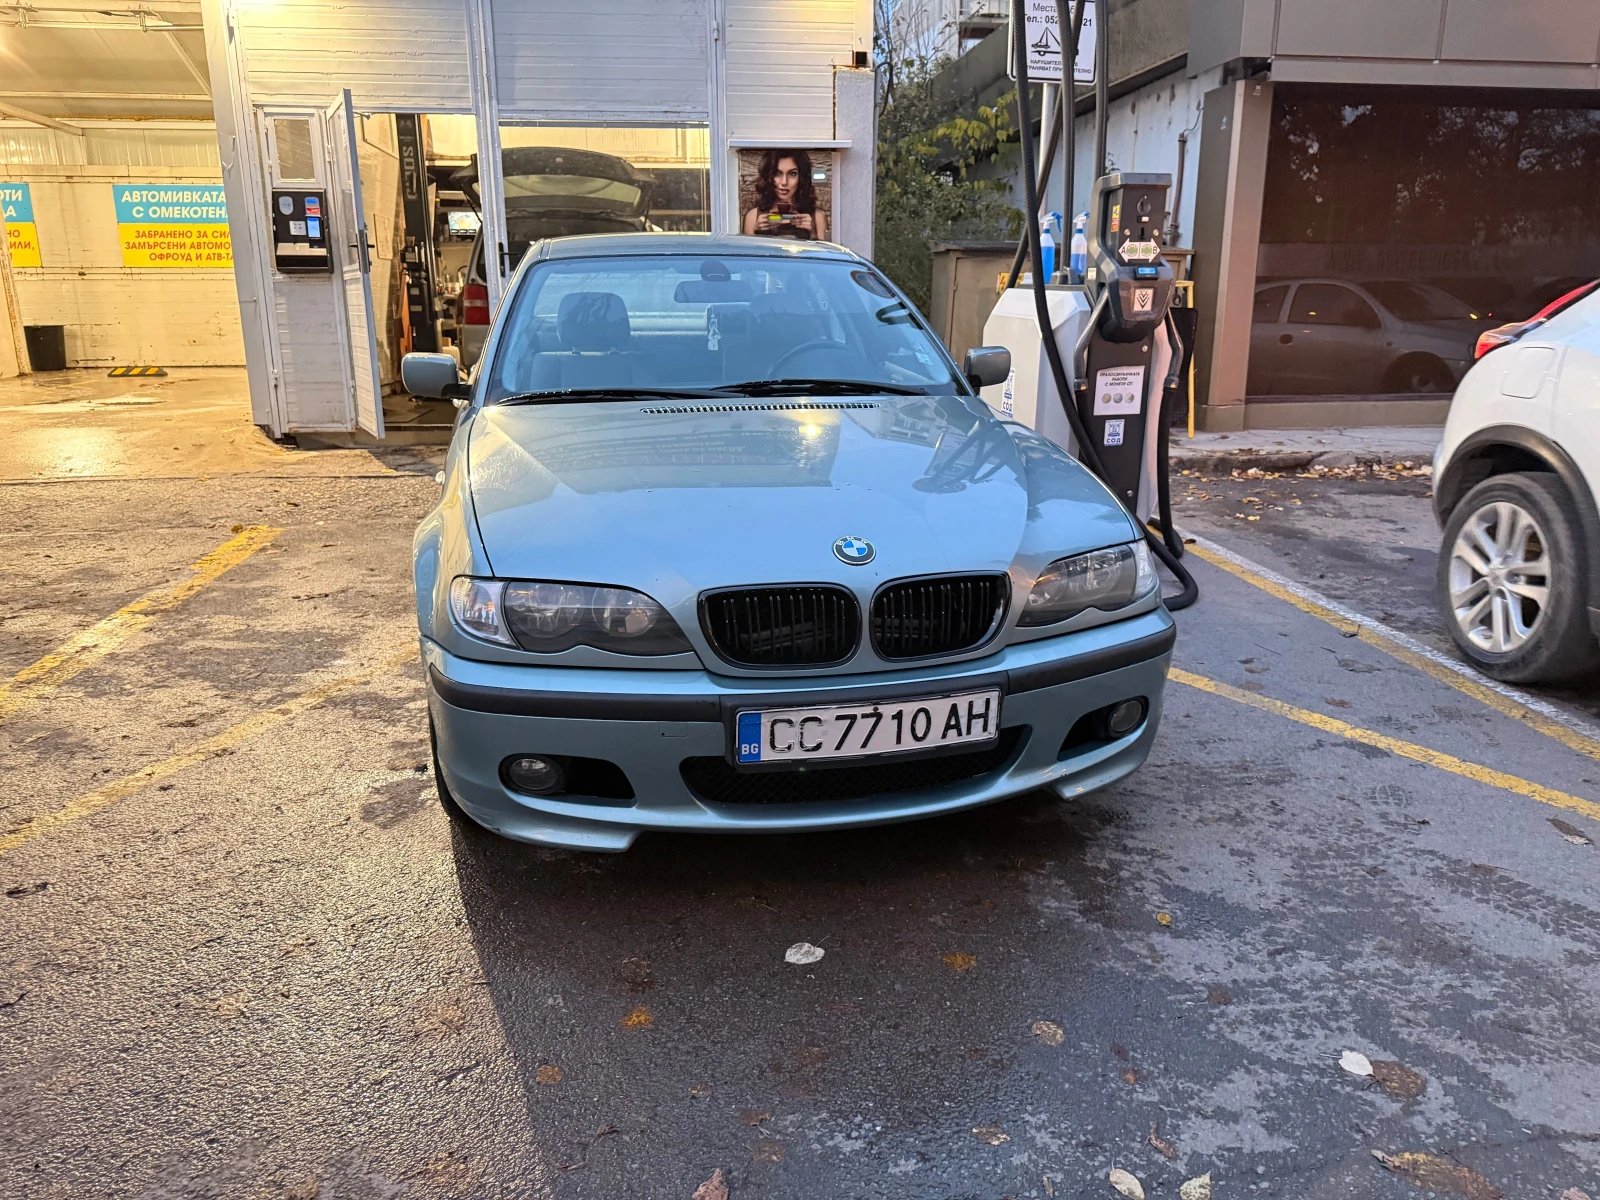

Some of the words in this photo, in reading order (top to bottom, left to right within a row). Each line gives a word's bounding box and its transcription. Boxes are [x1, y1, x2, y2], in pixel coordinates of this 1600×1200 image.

[1024, 13, 1043, 24] ел.:
[121, 190, 227, 203] АВТОМИВКАТА
[132, 206, 144, 218] С
[148, 206, 228, 219] ОМЕКОТЕН
[135, 230, 193, 239] ЗАБРАНЕНО
[196, 230, 209, 239] ЗА
[125, 241, 186, 250] ЗАМЪРСЕНИ
[149, 252, 193, 262] ОФРОУД
[195, 252, 203, 261] И
[741, 743, 759, 755] BG
